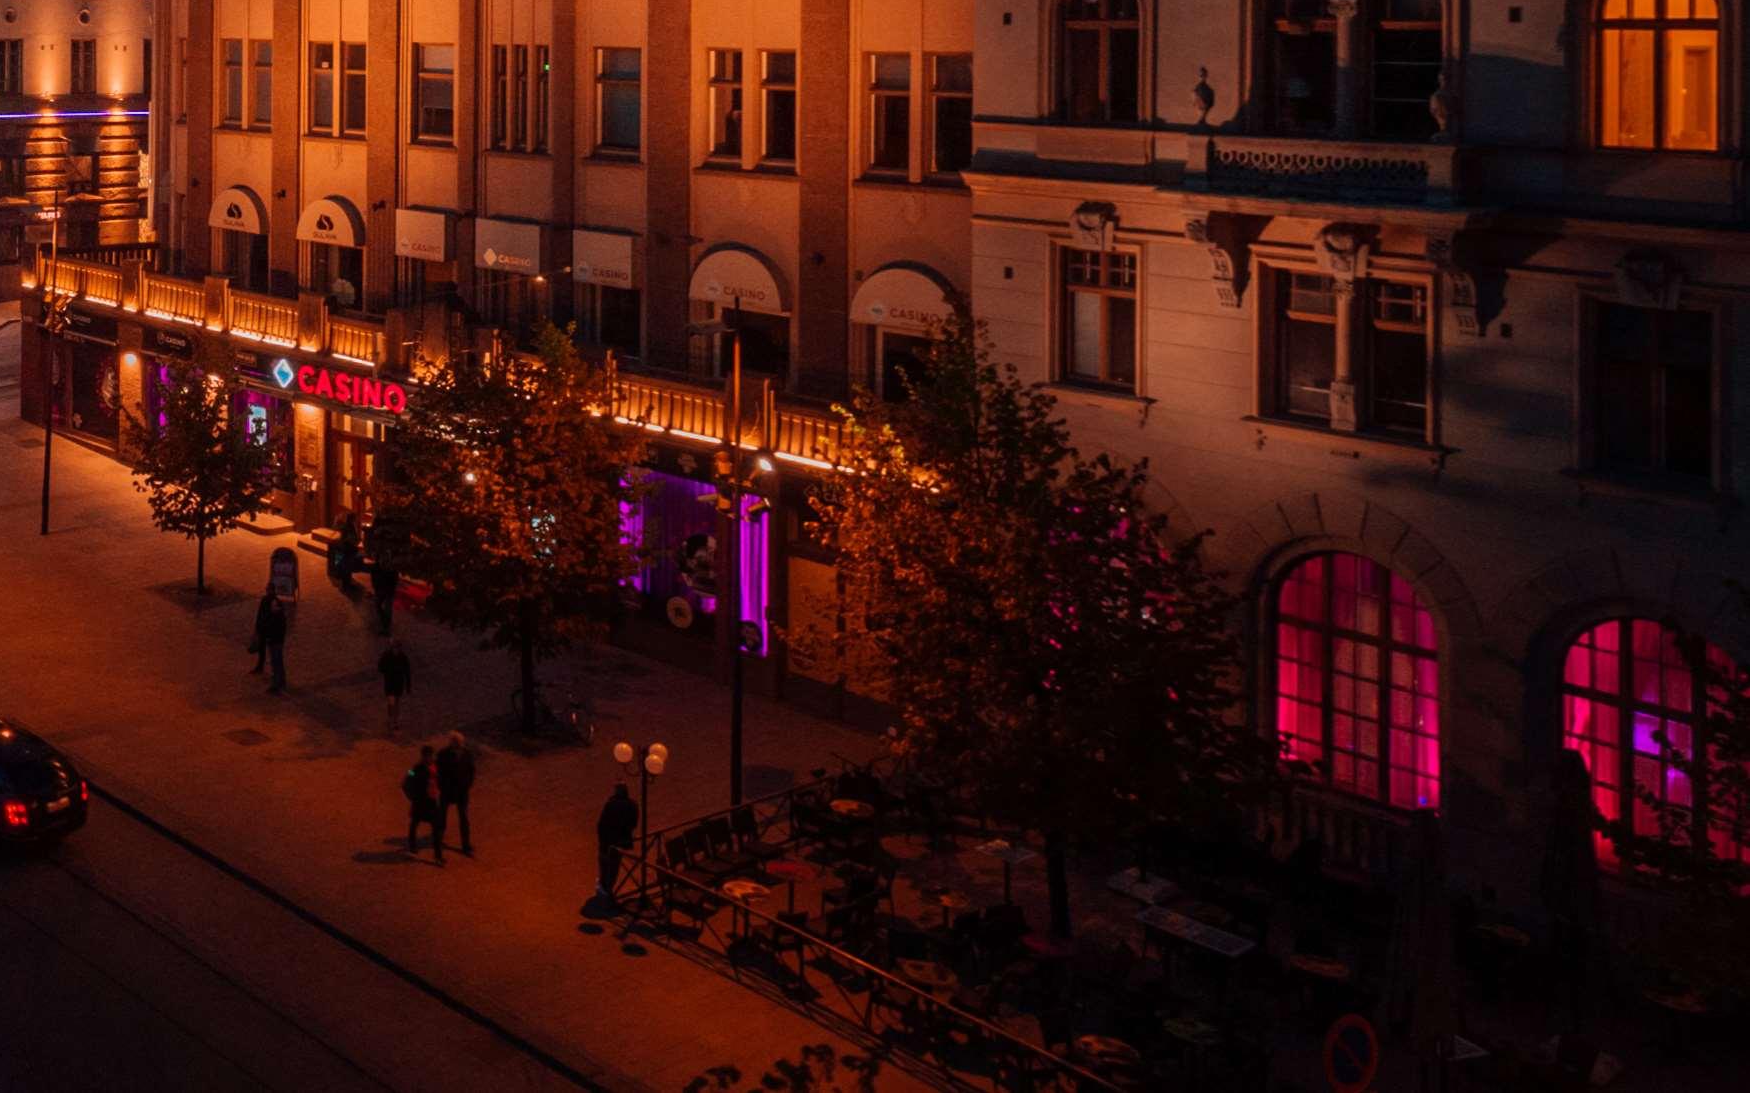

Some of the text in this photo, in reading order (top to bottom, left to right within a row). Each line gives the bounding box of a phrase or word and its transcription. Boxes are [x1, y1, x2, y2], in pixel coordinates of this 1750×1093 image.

[592, 268, 629, 281] CASINO
[723, 285, 766, 301] CASINO
[889, 308, 940, 322] CASINO
[297, 365, 408, 413] CASINO
